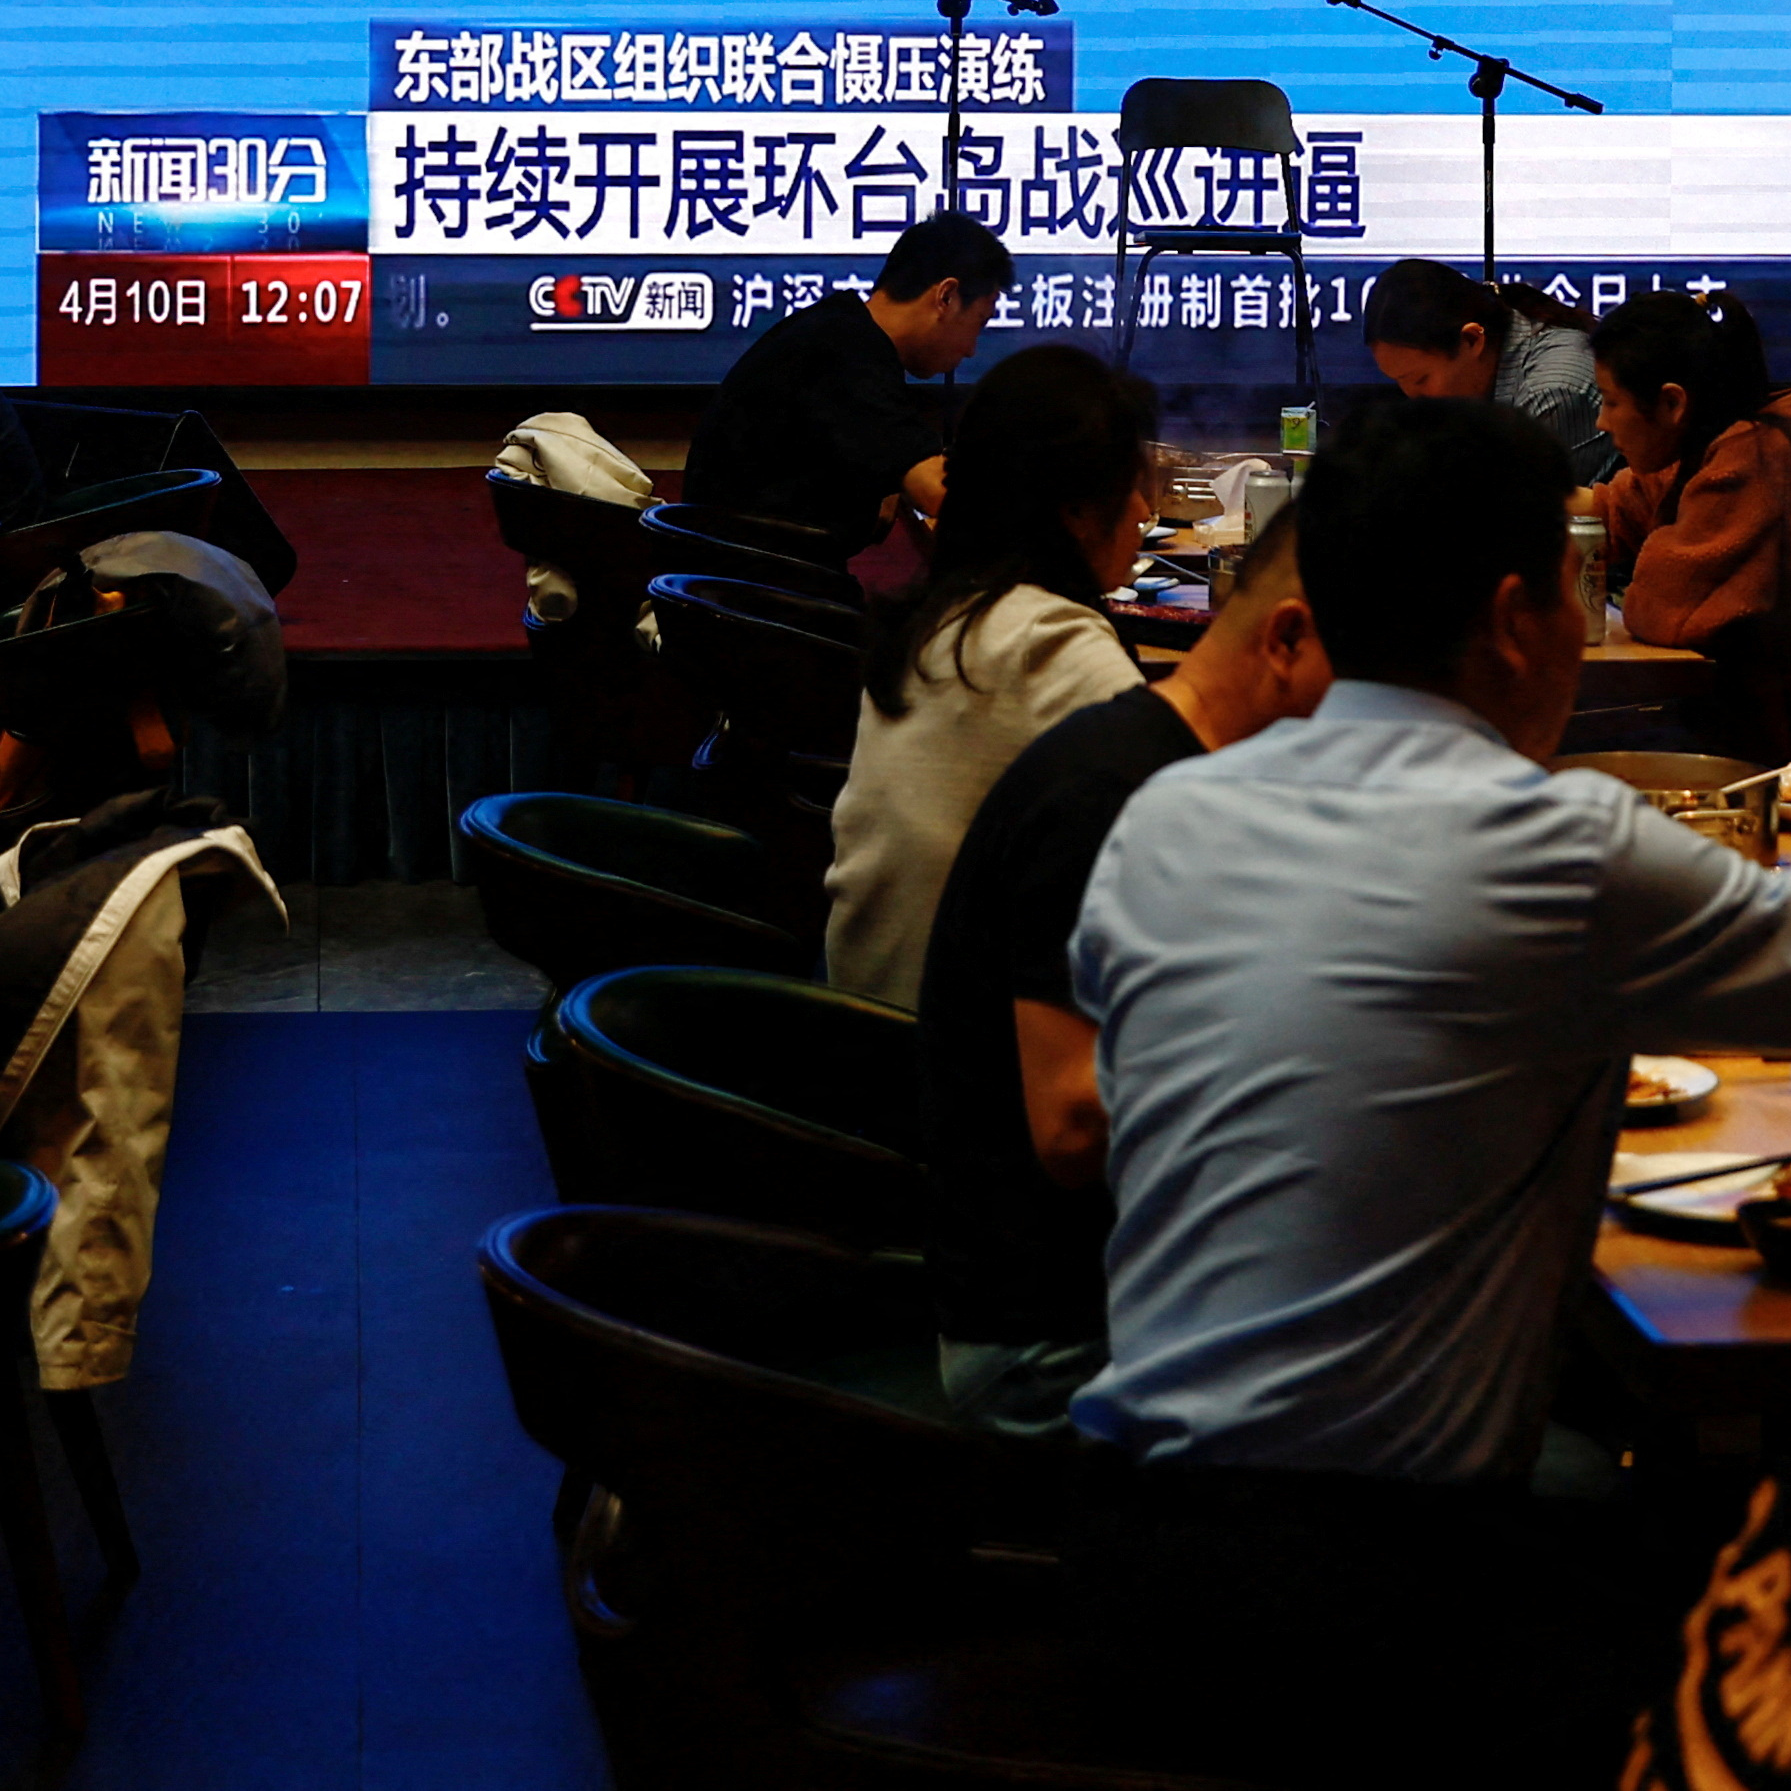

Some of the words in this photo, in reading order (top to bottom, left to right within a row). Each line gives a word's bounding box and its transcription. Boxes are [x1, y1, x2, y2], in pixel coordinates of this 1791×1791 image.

[394, 30, 1047, 107] 东部战区组织联合慑压演练
[87, 135, 327, 204] 新闻30分
[394, 123, 1366, 241] 持续开展环台岛战巡进逼
[59, 277, 206, 326] 4月10日
[241, 279, 362, 324] 12:07
[529, 274, 635, 317] CCTV
[645, 279, 706, 320] 新闻
